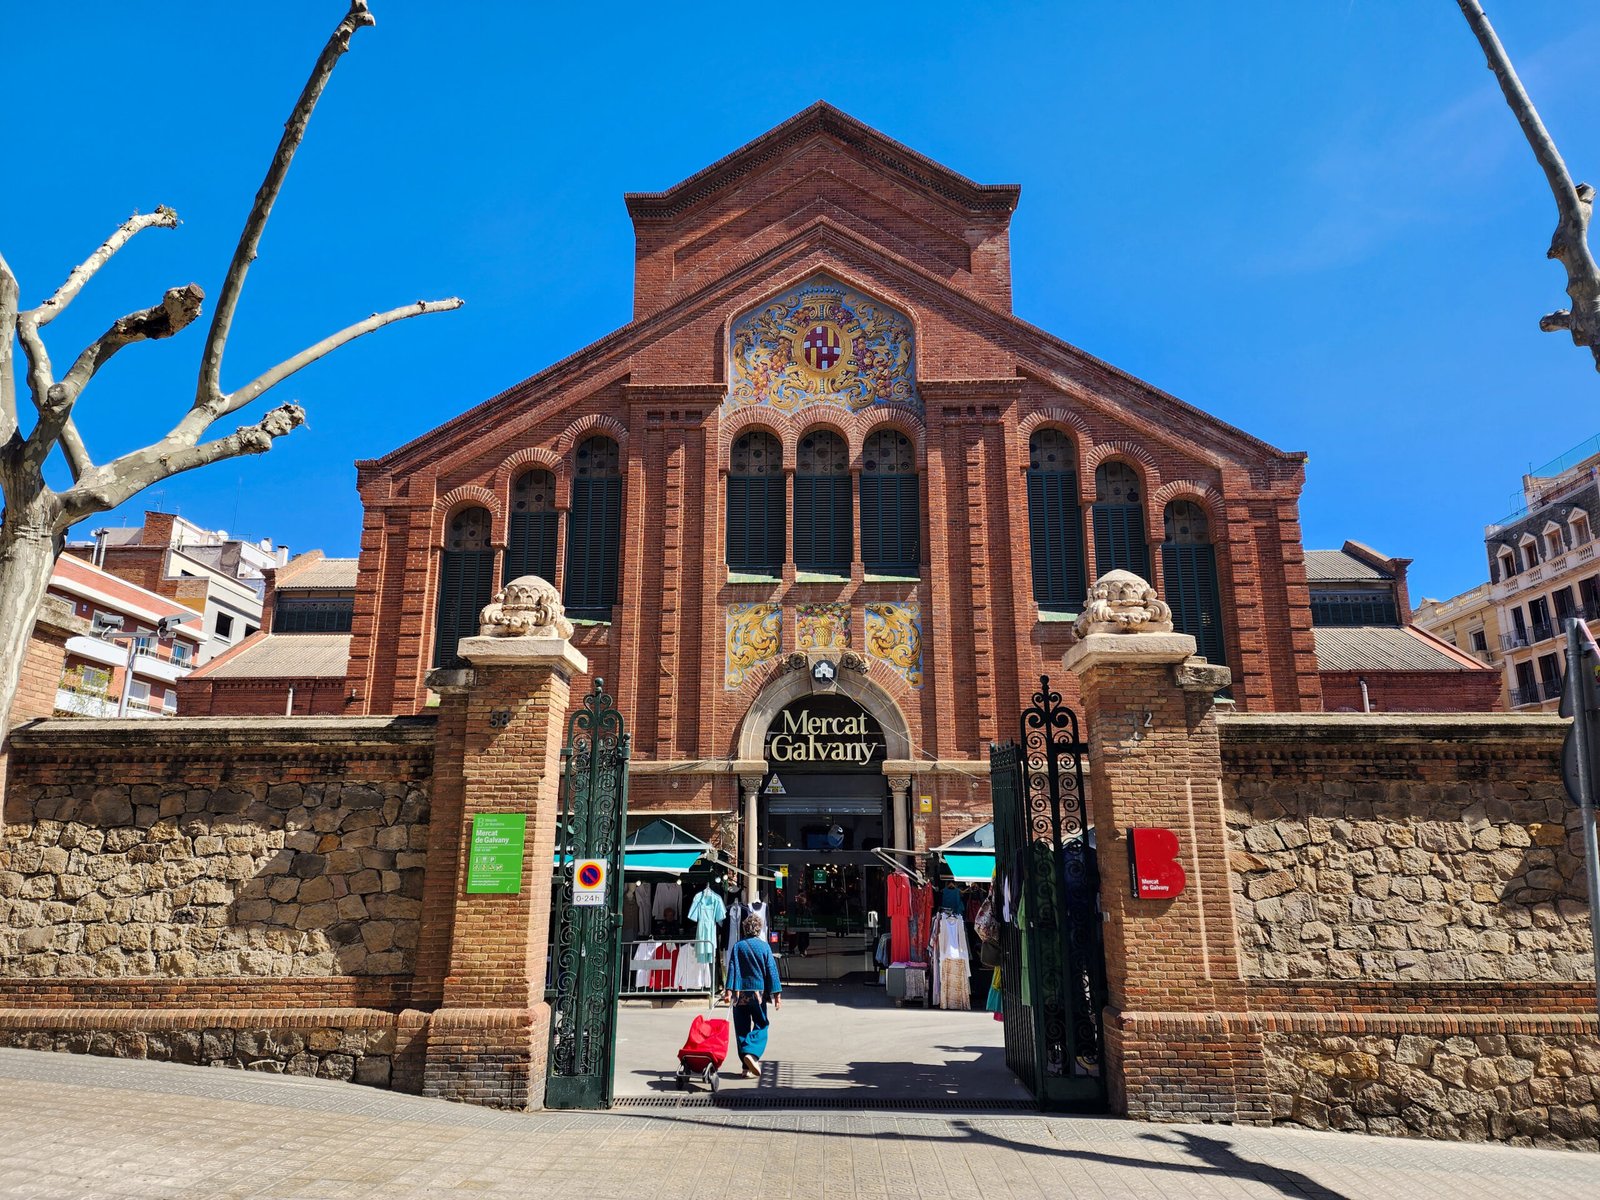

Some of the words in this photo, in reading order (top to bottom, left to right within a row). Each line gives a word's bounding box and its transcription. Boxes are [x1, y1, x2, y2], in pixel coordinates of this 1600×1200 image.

[490, 711, 509, 728] 58
[783, 709, 868, 735] Mercat
[1143, 711, 1154, 728] 2
[771, 735, 877, 765] Galvany
[484, 837, 510, 845] Galvany
